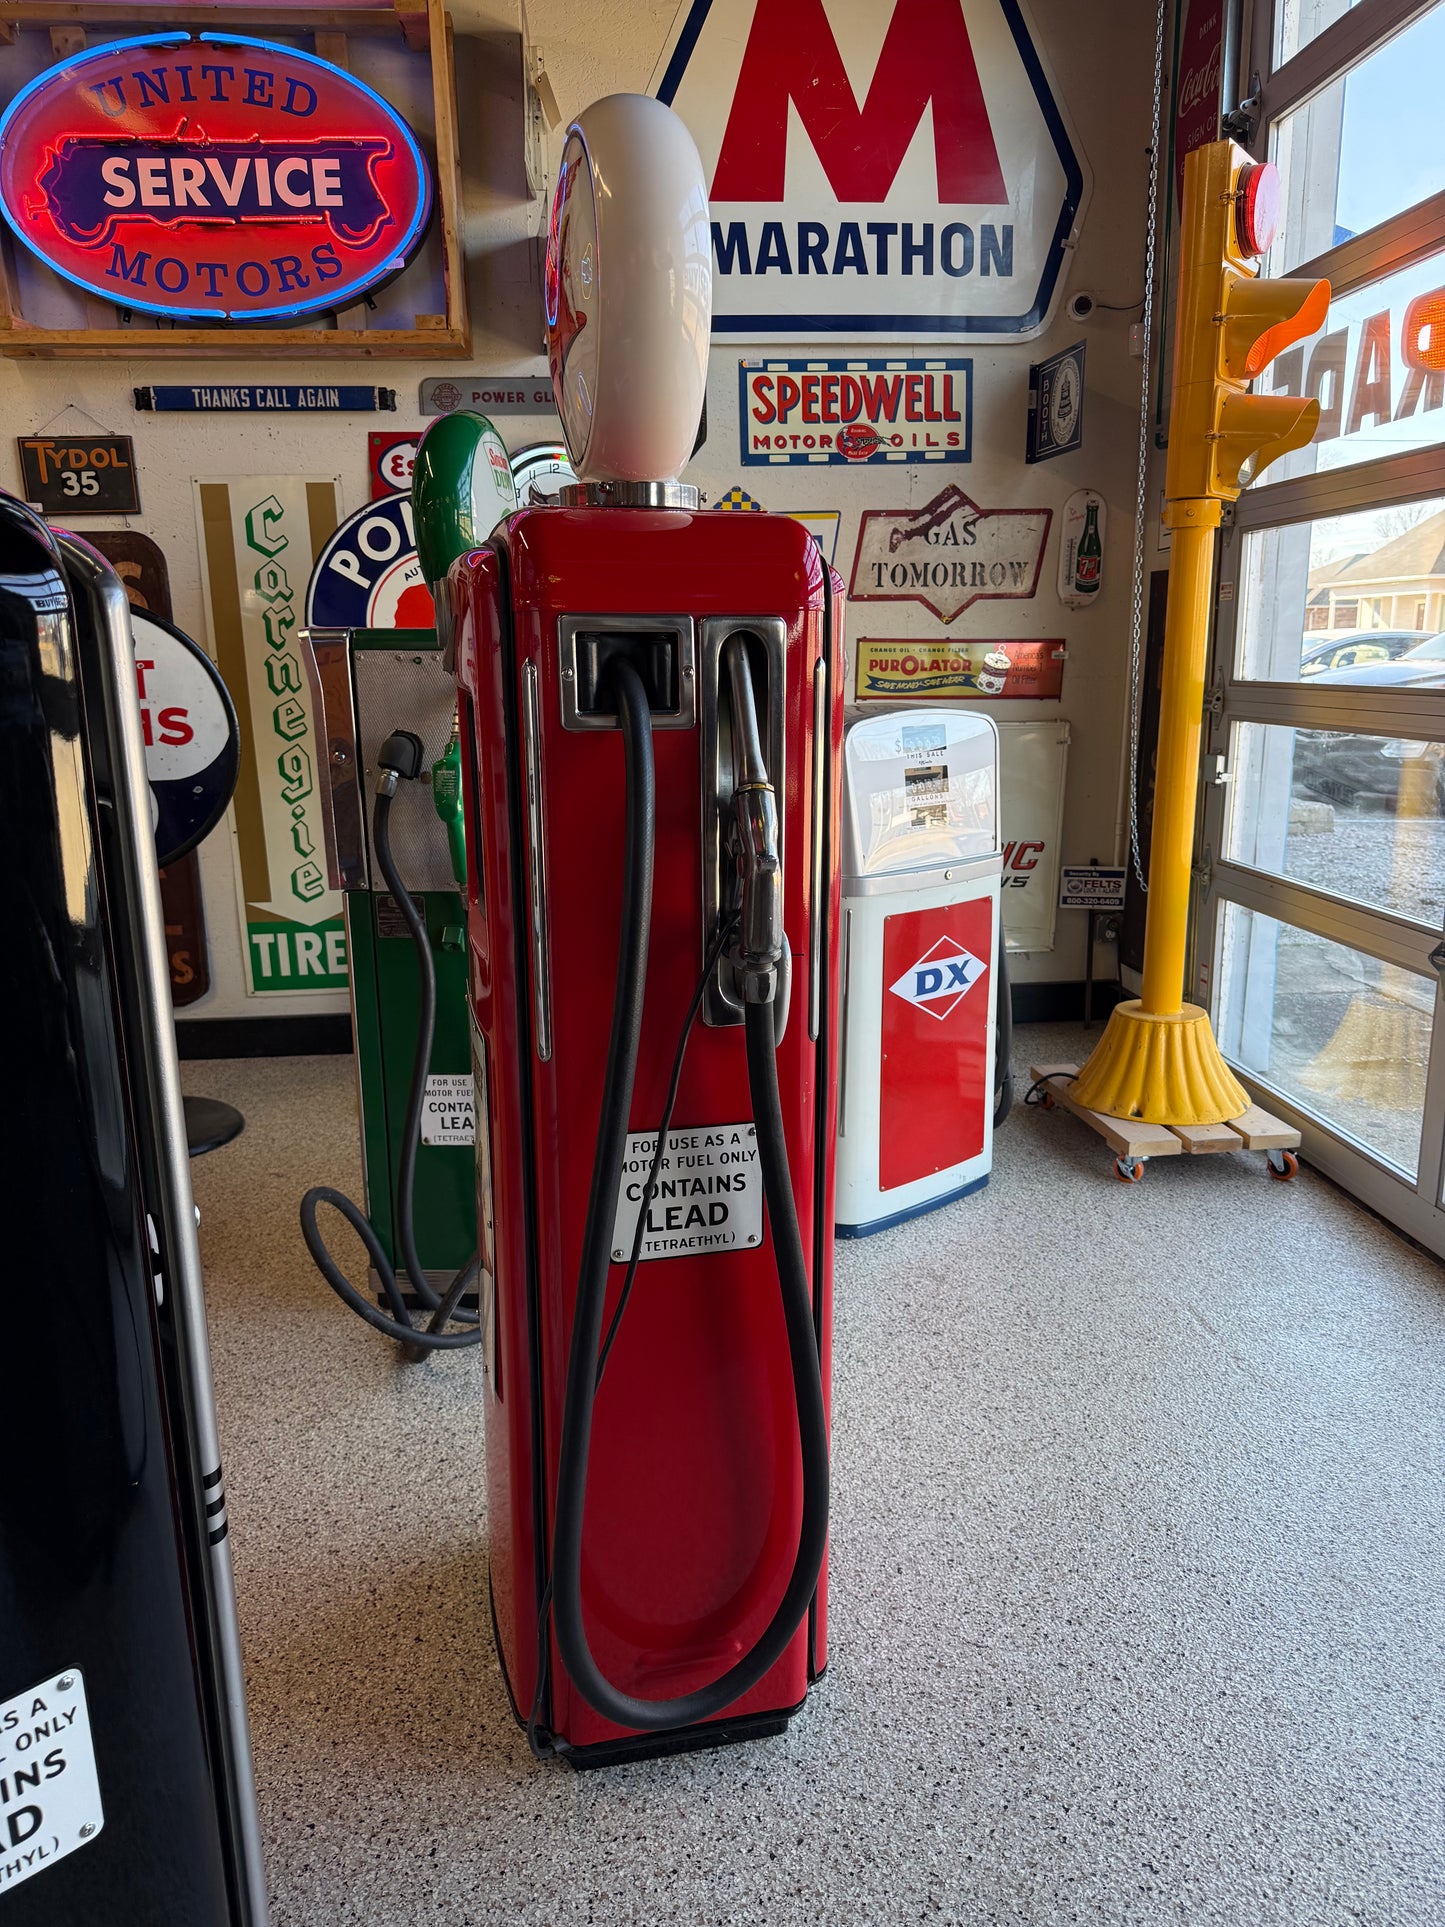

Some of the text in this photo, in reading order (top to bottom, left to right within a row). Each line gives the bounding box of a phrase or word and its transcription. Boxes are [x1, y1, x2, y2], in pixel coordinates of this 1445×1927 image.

[89, 65, 318, 117] UNITED
[101, 157, 344, 207] SERVICE
[711, 222, 1014, 278] MARATHON
[105, 242, 343, 297] MOTORS
[192, 388, 340, 408] THANKS CALL AGAIN
[471, 391, 526, 404] POWER
[752, 374, 962, 424] SPEEDWELL
[1041, 379, 1050, 441] BOOTH
[753, 431, 960, 449] MOTOR OILS
[25, 441, 128, 484] TYDOL
[549, 463, 560, 474] 12
[61, 471, 100, 496] 35
[923, 520, 978, 547] GAS
[871, 561, 1030, 588] TOMORROW
[868, 655, 973, 676] PUROLATOR
[245, 494, 324, 903] Carnegie
[1084, 879, 1122, 889] FELTS
[252, 930, 348, 979] TIRE
[913, 958, 973, 998] DX
[424, 1089, 453, 1097] MOTOR
[432, 1078, 468, 1087] FOR USE
[428, 1102, 474, 1113] CONTA
[440, 1116, 475, 1130] LEA
[669, 1136, 699, 1151] USE
[704, 1134, 725, 1148] AS
[730, 1132, 741, 1145] A
[677, 1154, 715, 1169] FUEL
[720, 1149, 757, 1164] ONLY
[626, 1172, 747, 1202] CONTAINS
[646, 1201, 730, 1233] LEAD
[644, 1231, 736, 1252] TETRAETHYL)
[31, 1697, 48, 1718] A
[16, 1705, 77, 1751] ONLY
[0, 1748, 67, 1804] INS
[0, 1804, 43, 1853] D
